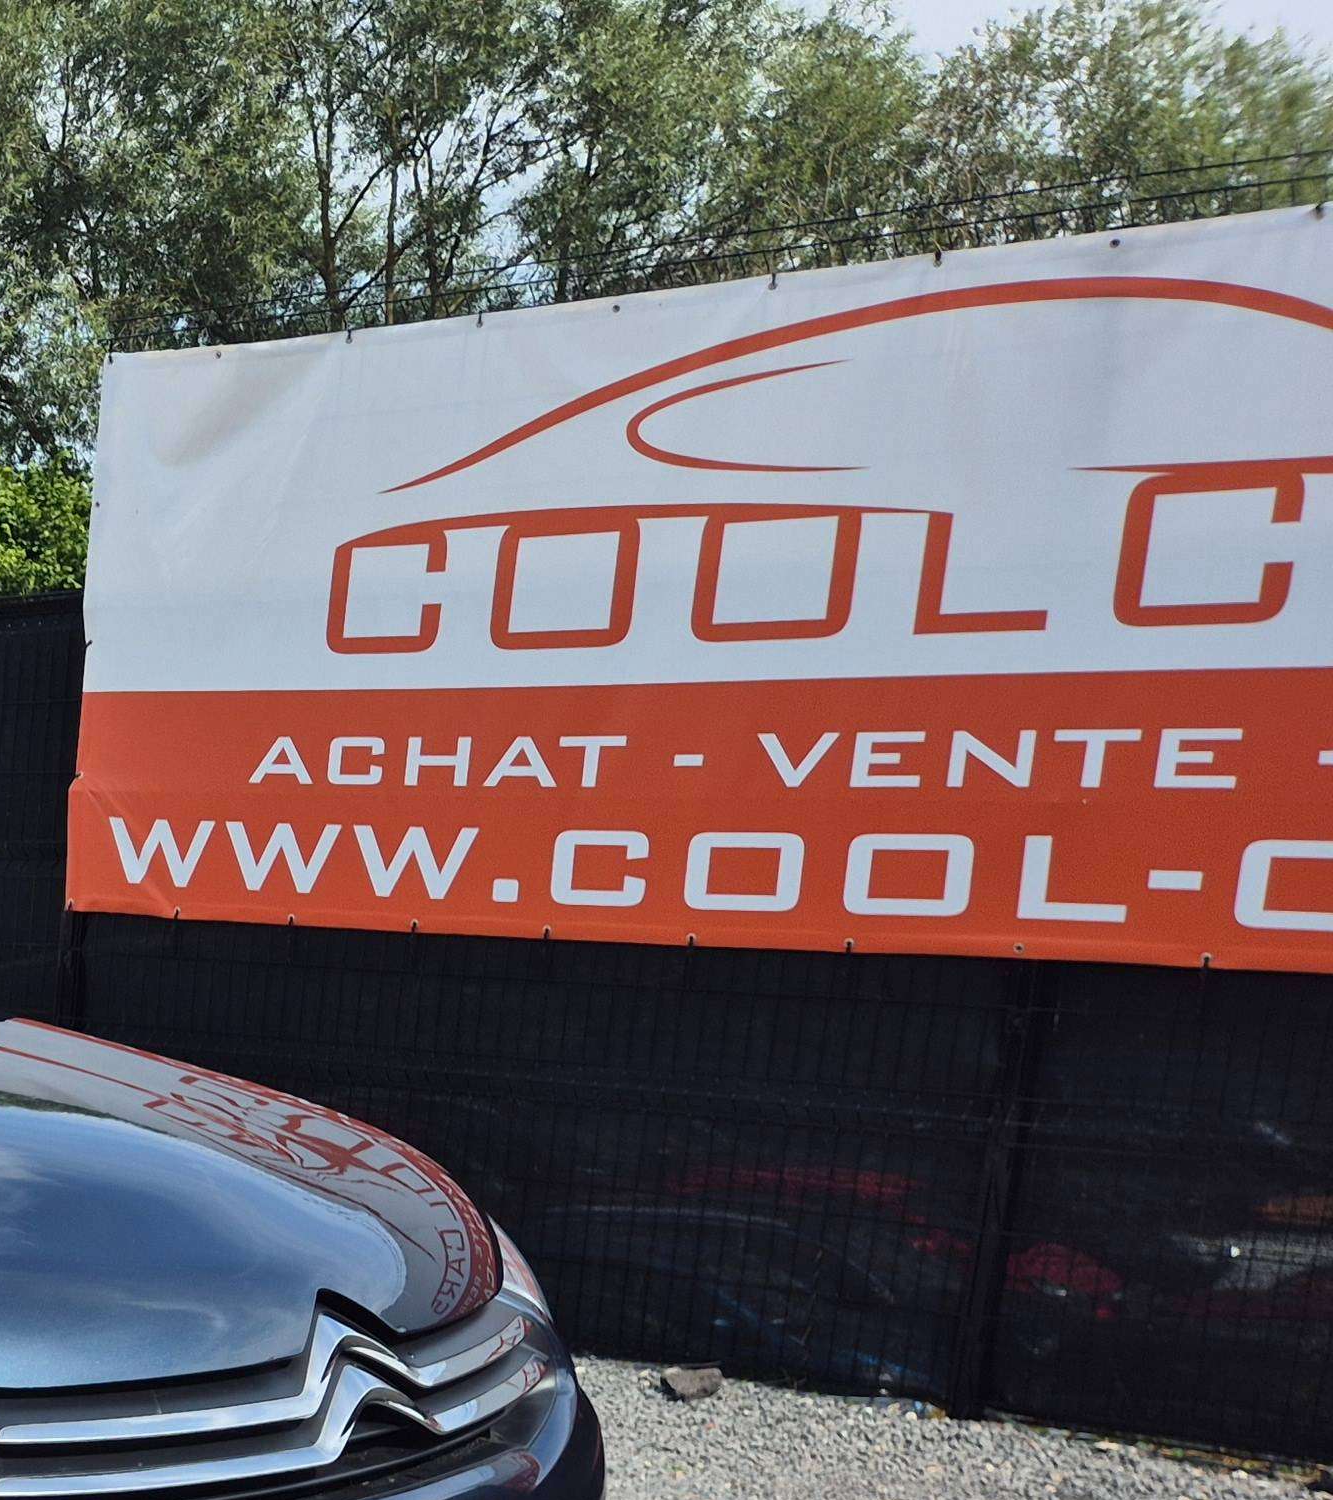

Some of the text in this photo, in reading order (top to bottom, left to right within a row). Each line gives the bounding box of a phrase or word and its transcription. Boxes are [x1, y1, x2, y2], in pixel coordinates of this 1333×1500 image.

[326, 503, 1047, 654] COOL
[248, 735, 627, 788] ACHAT
[758, 728, 1243, 789] VENTE
